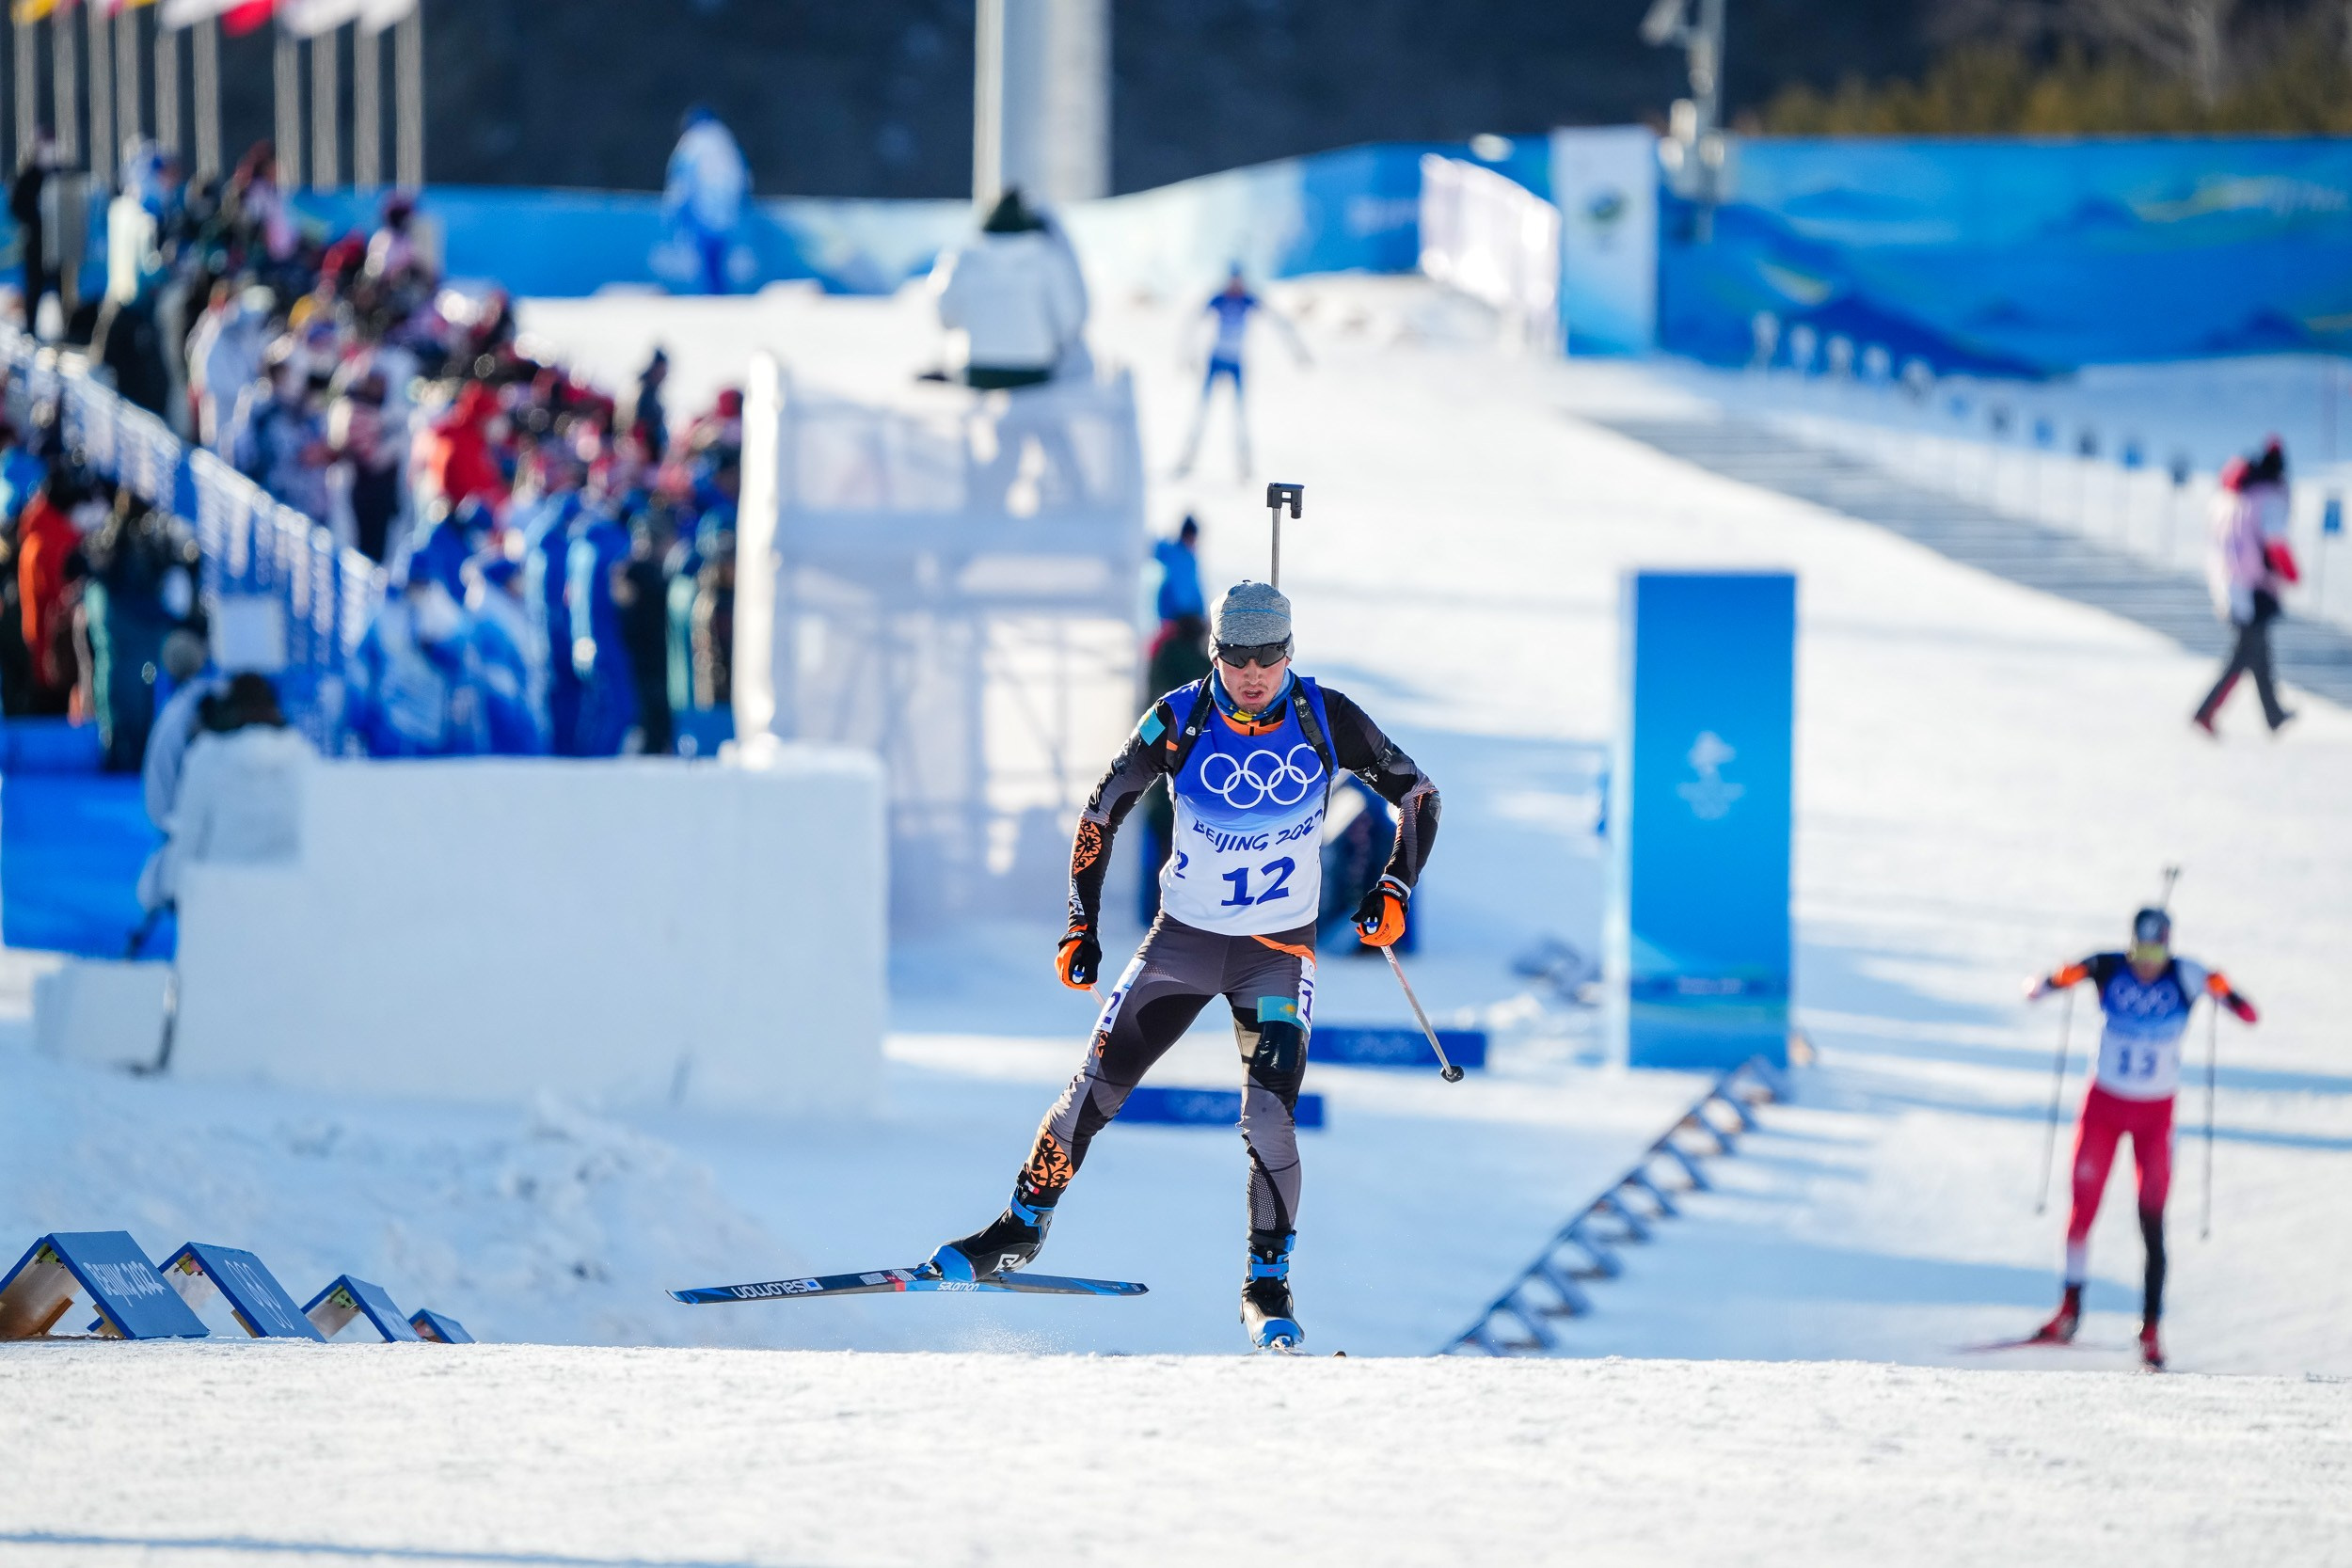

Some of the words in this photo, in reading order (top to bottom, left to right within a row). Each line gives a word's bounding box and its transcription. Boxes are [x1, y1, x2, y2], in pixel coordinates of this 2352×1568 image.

[1193, 817, 1269, 853] BEIJING
[1220, 856, 1295, 906] 12
[83, 1261, 142, 1307] BEIJING
[120, 1260, 166, 1296] 2022
